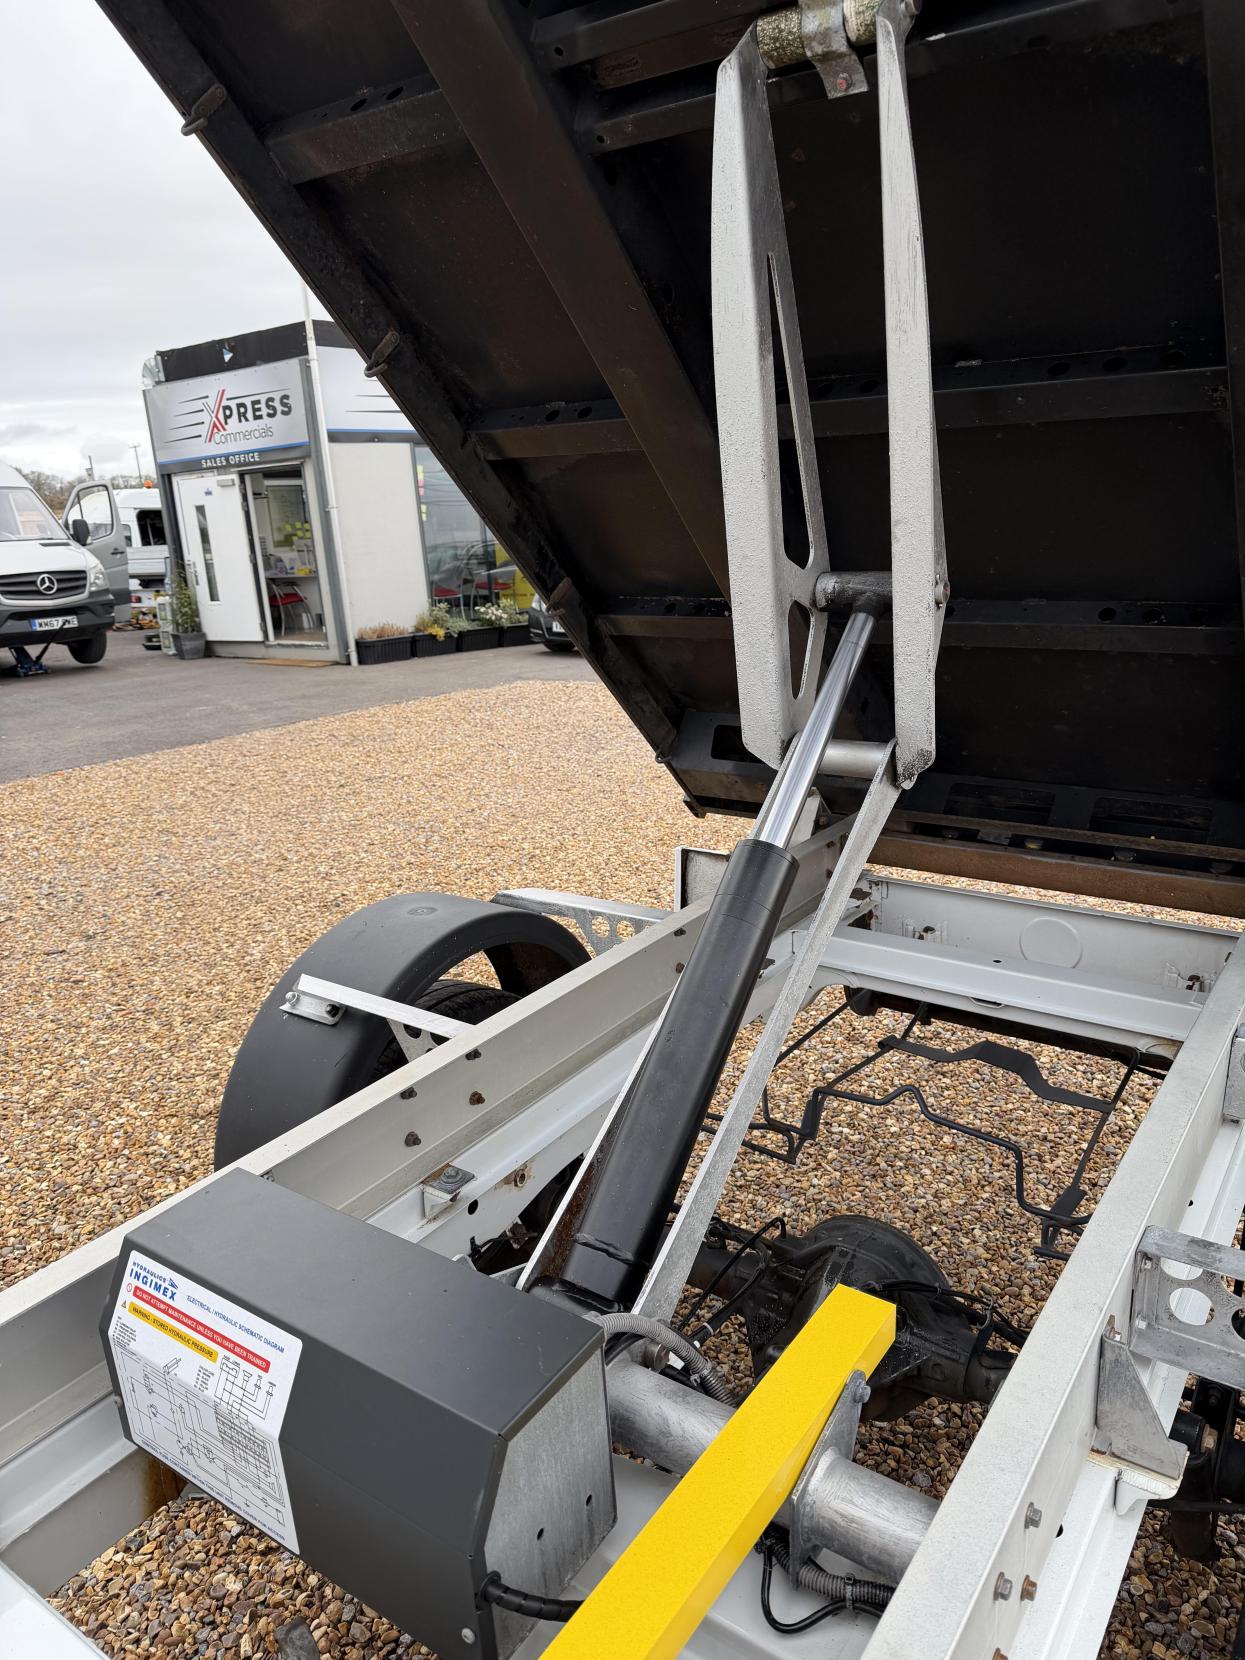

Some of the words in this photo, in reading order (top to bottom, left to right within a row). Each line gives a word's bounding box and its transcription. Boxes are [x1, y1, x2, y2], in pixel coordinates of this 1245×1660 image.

[202, 388, 292, 443] XPRESS
[213, 424, 274, 445] Commercials
[202, 457, 226, 468] SALES
[229, 452, 261, 464] OFFICE
[129, 1268, 177, 1302] INGIMEX
[132, 1261, 167, 1284] HYDRAULICS
[132, 1304, 150, 1321] WARNING
[153, 1316, 168, 1331] STORED
[168, 1326, 191, 1345] HYDRAULIC
[191, 1340, 214, 1358] PRESSURE
[143, 1292, 151, 1301] NOT
[151, 1296, 168, 1312] ATTEMPT
[168, 1304, 197, 1327] MAINTENANCE
[197, 1321, 213, 1338] UNLESS
[213, 1333, 222, 1343] YOU
[222, 1338, 234, 1350] HAVE
[234, 1344, 247, 1357] BEEN
[247, 1352, 266, 1368] TRAINED
[186, 1295, 212, 1314] ELECTRICAL
[214, 1310, 238, 1328] HYDRAULIC
[238, 1323, 263, 1342] SCHEMATIC
[263, 1337, 285, 1354] DIAGRAM
